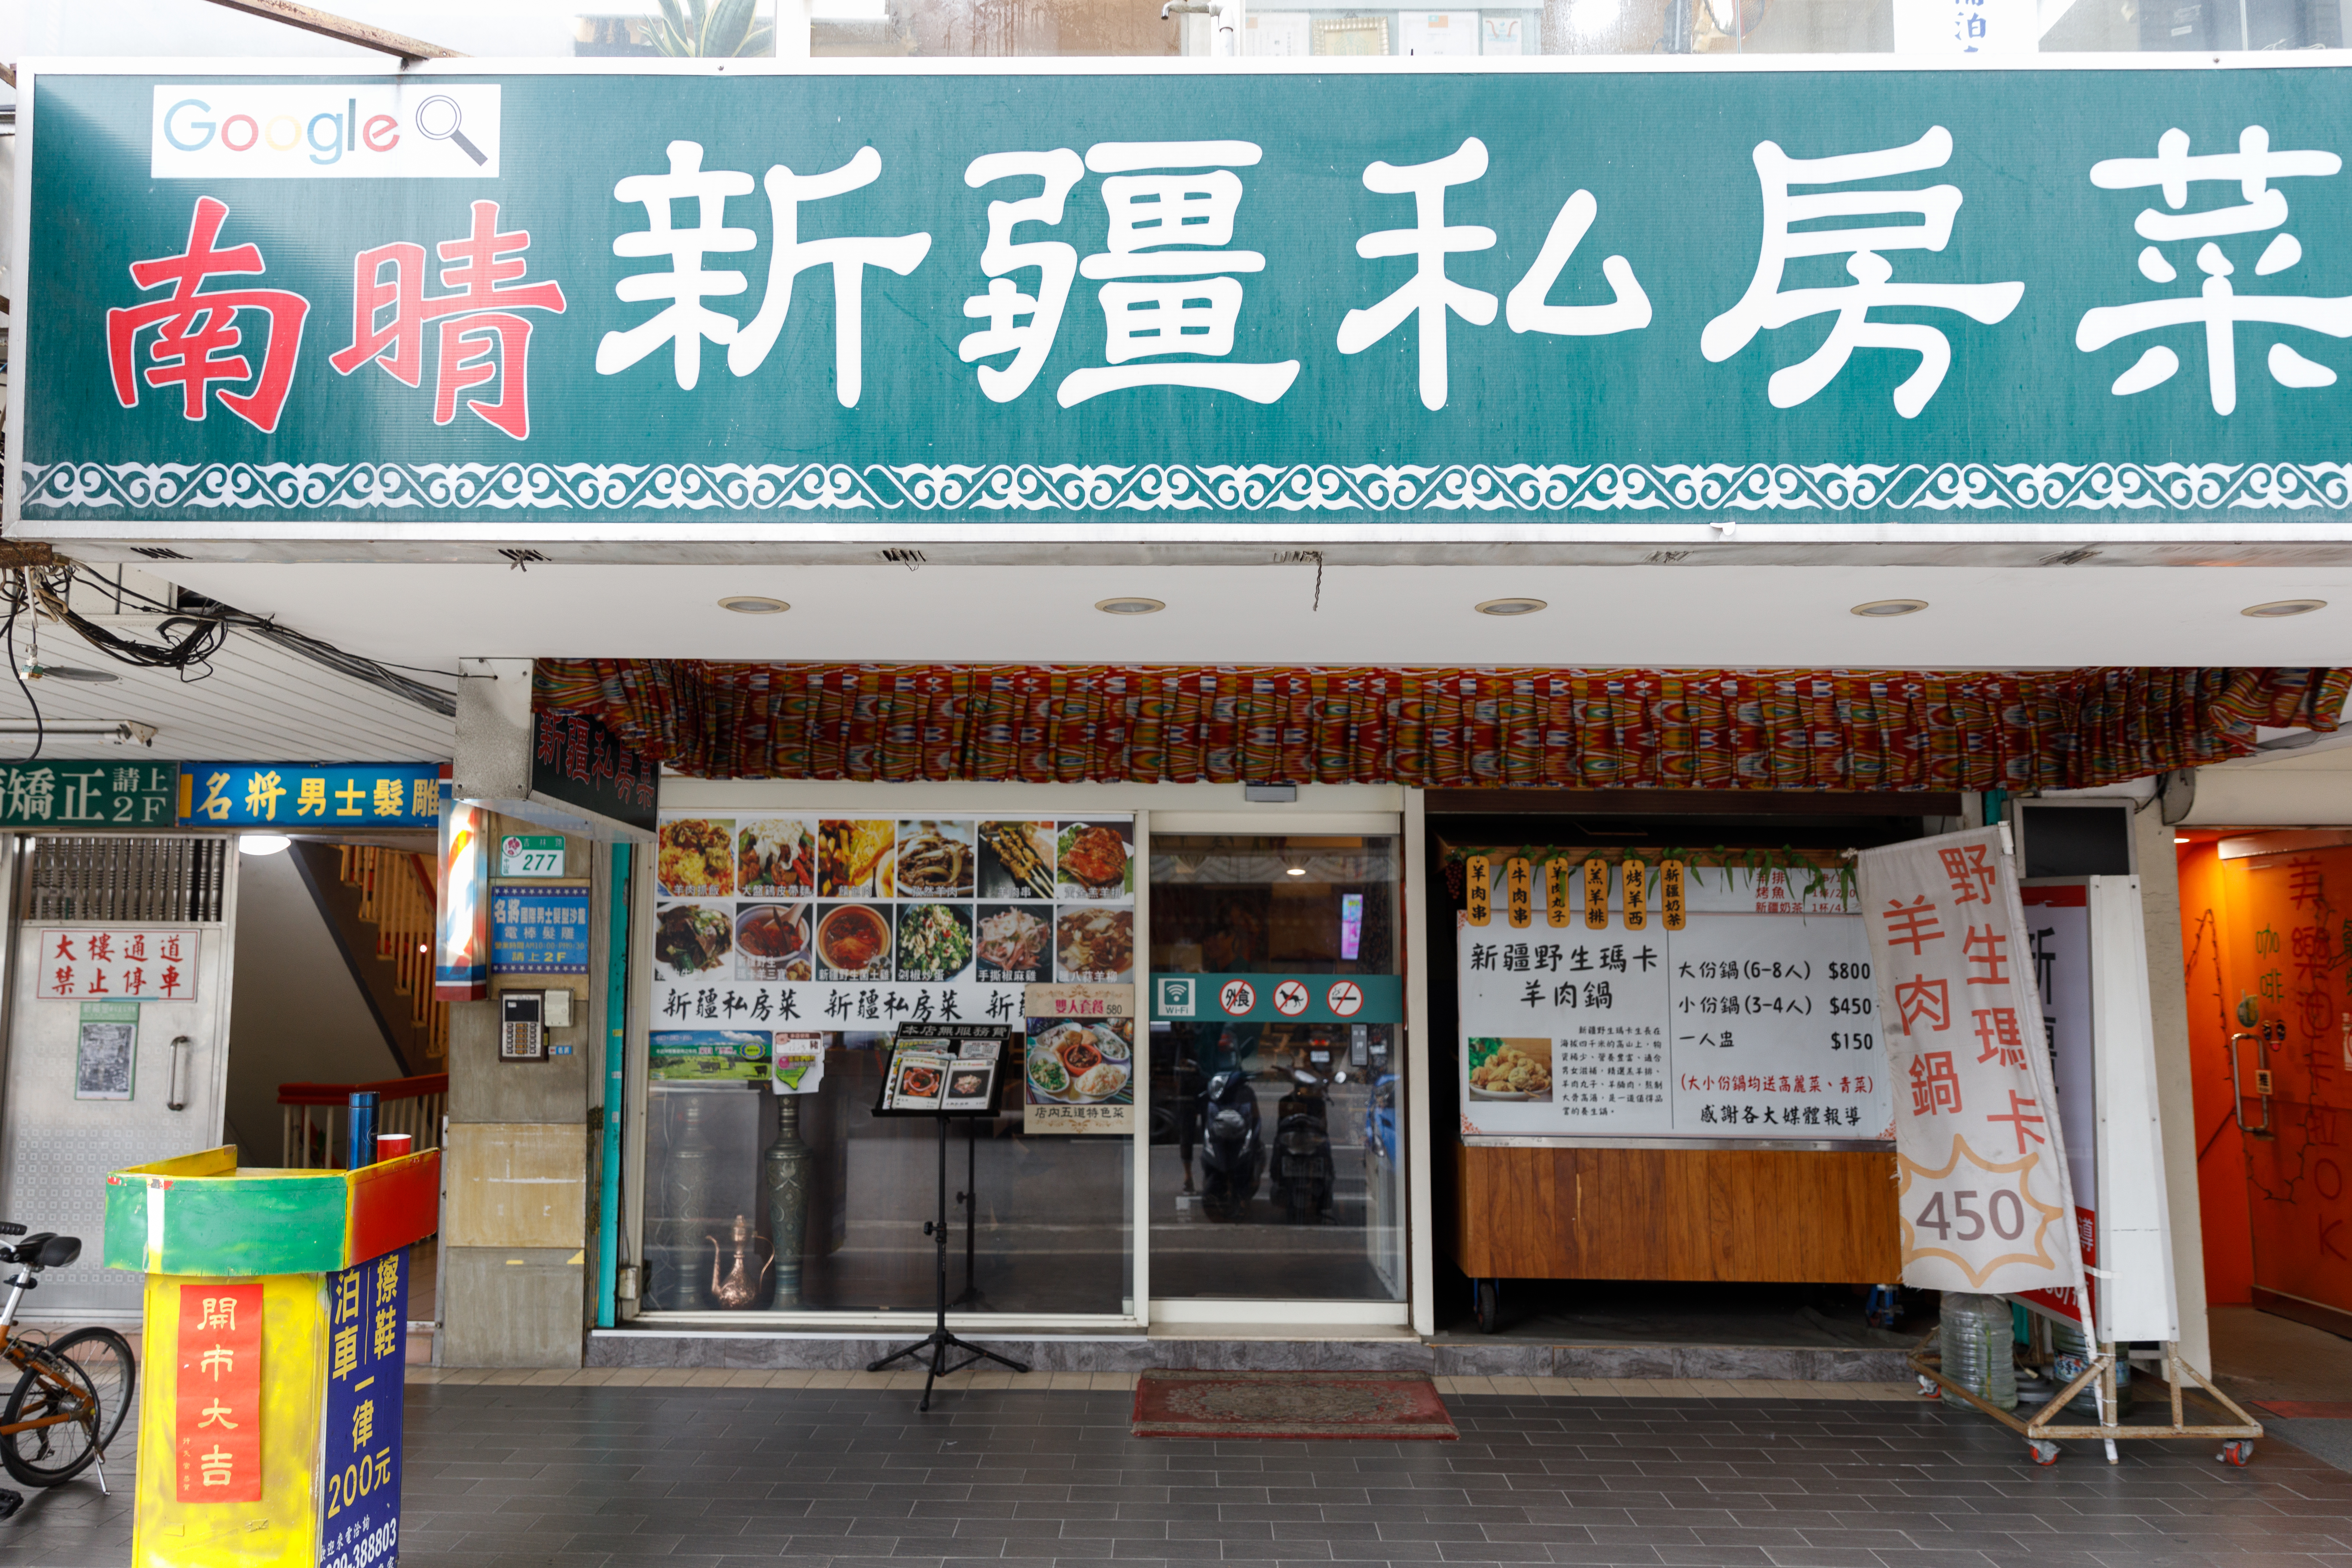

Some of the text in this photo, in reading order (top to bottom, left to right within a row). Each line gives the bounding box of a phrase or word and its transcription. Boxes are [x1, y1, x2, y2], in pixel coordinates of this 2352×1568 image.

[164, 98, 401, 166] Google
[106, 125, 2352, 440] 南晴 新疆私房菜
[0, 767, 105, 821] 矯正
[523, 854, 557, 870] 277
[998, 886, 1031, 898] 羊肉串
[1471, 865, 1487, 921] 羊肉串
[1512, 867, 1528, 924] 牛肉串
[1588, 868, 1604, 923] 羔羊排
[1665, 869, 1681, 926] 新疆奶茶
[1756, 902, 1802, 913] 新疆奶茶
[55, 933, 183, 962] 大樓通道
[1471, 943, 1657, 972] 新疆野生瑪卡
[1679, 960, 1871, 980] 大份鍋(6-8人) $800
[2256, 923, 2284, 1003] 咖啡
[52, 965, 180, 997] 禁止停車
[663, 988, 1025, 1022] 新疆私房菜 新疆私房菜 新
[1055, 999, 1122, 1014] 雙人套餐 580
[1521, 979, 1613, 1008] 羊肉鍋
[1679, 995, 1872, 1015] 小份鍋(3-4人) $450
[1882, 894, 1963, 1116] 羊肉鍋
[1938, 844, 2046, 1154] 野生瑪卡
[903, 1025, 1007, 1037] 本店無服務費
[1831, 1032, 1872, 1050] $150
[1701, 1104, 1861, 1126] 感謝各大媒體報導
[1916, 1189, 2025, 1241] 450
[332, 1269, 360, 1381] 泊車
[374, 1254, 399, 1360] 擦鞋
[197, 1297, 238, 1487] 開市大吉
[328, 1446, 391, 1519] 200元
